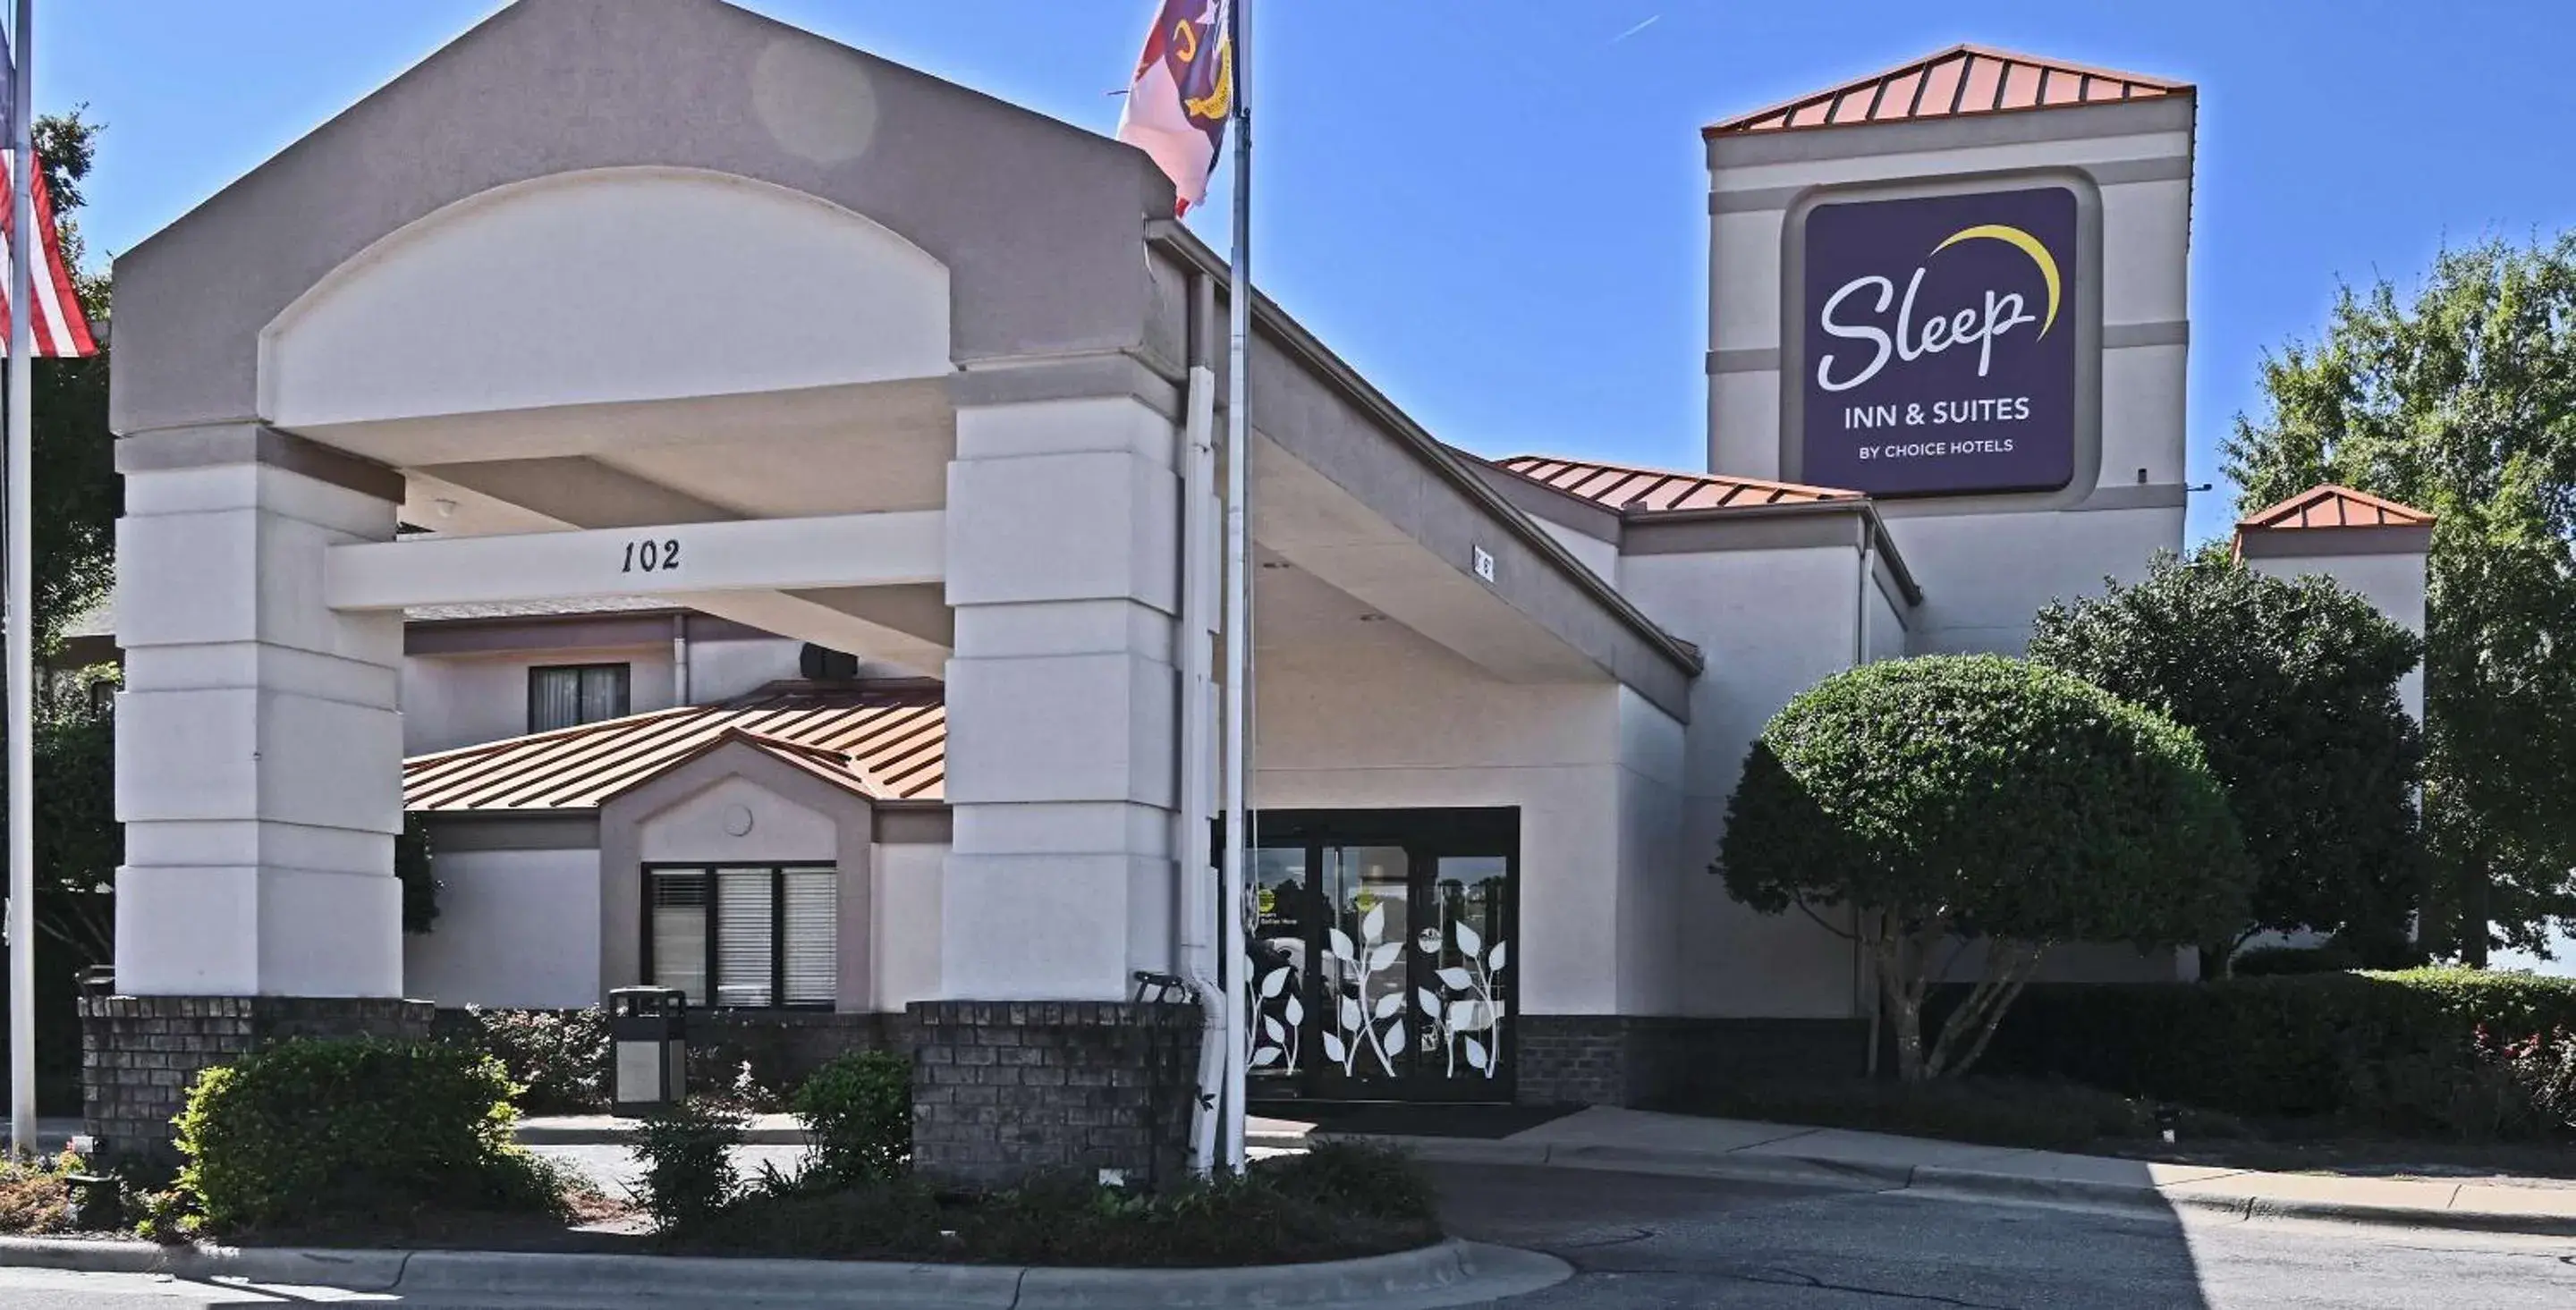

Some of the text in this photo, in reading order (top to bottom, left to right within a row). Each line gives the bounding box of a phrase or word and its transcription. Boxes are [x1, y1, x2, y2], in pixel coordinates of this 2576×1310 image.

[1818, 267, 2036, 392] Sleep
[1845, 397, 2029, 428] INN & SUITES
[1859, 438, 2013, 460] BY CHOICE HOTELS
[622, 539, 680, 573] 102
